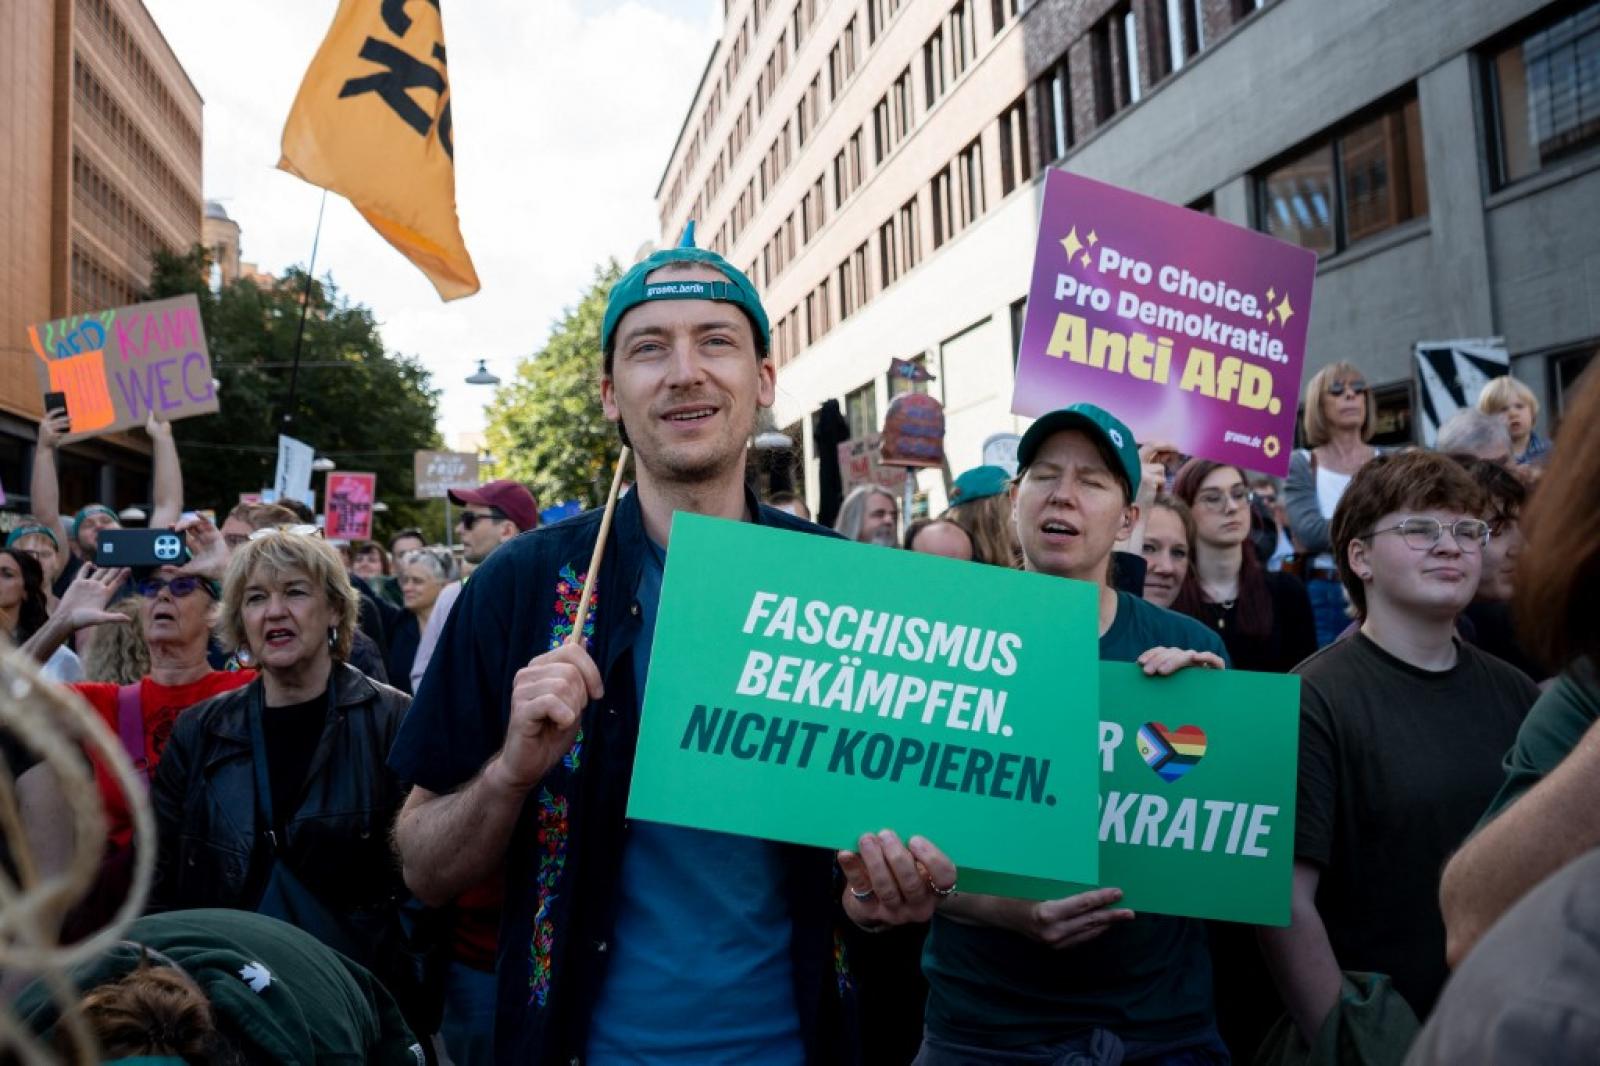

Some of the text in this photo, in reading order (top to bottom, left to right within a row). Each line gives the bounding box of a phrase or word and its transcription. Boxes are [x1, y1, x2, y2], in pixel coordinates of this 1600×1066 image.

[1054, 273, 1289, 364] Pro Demokratie.
[1099, 247, 1263, 320] Pro Choice.
[115, 352, 214, 420] WEG
[1046, 312, 1282, 416] Anti AfD.
[741, 591, 1023, 676] FASCHISMUS
[736, 649, 1014, 737] BEKÄMPFEN.
[679, 704, 1058, 806] NICHT KOPIEREN.
[1098, 791, 1279, 857] KRATIE
